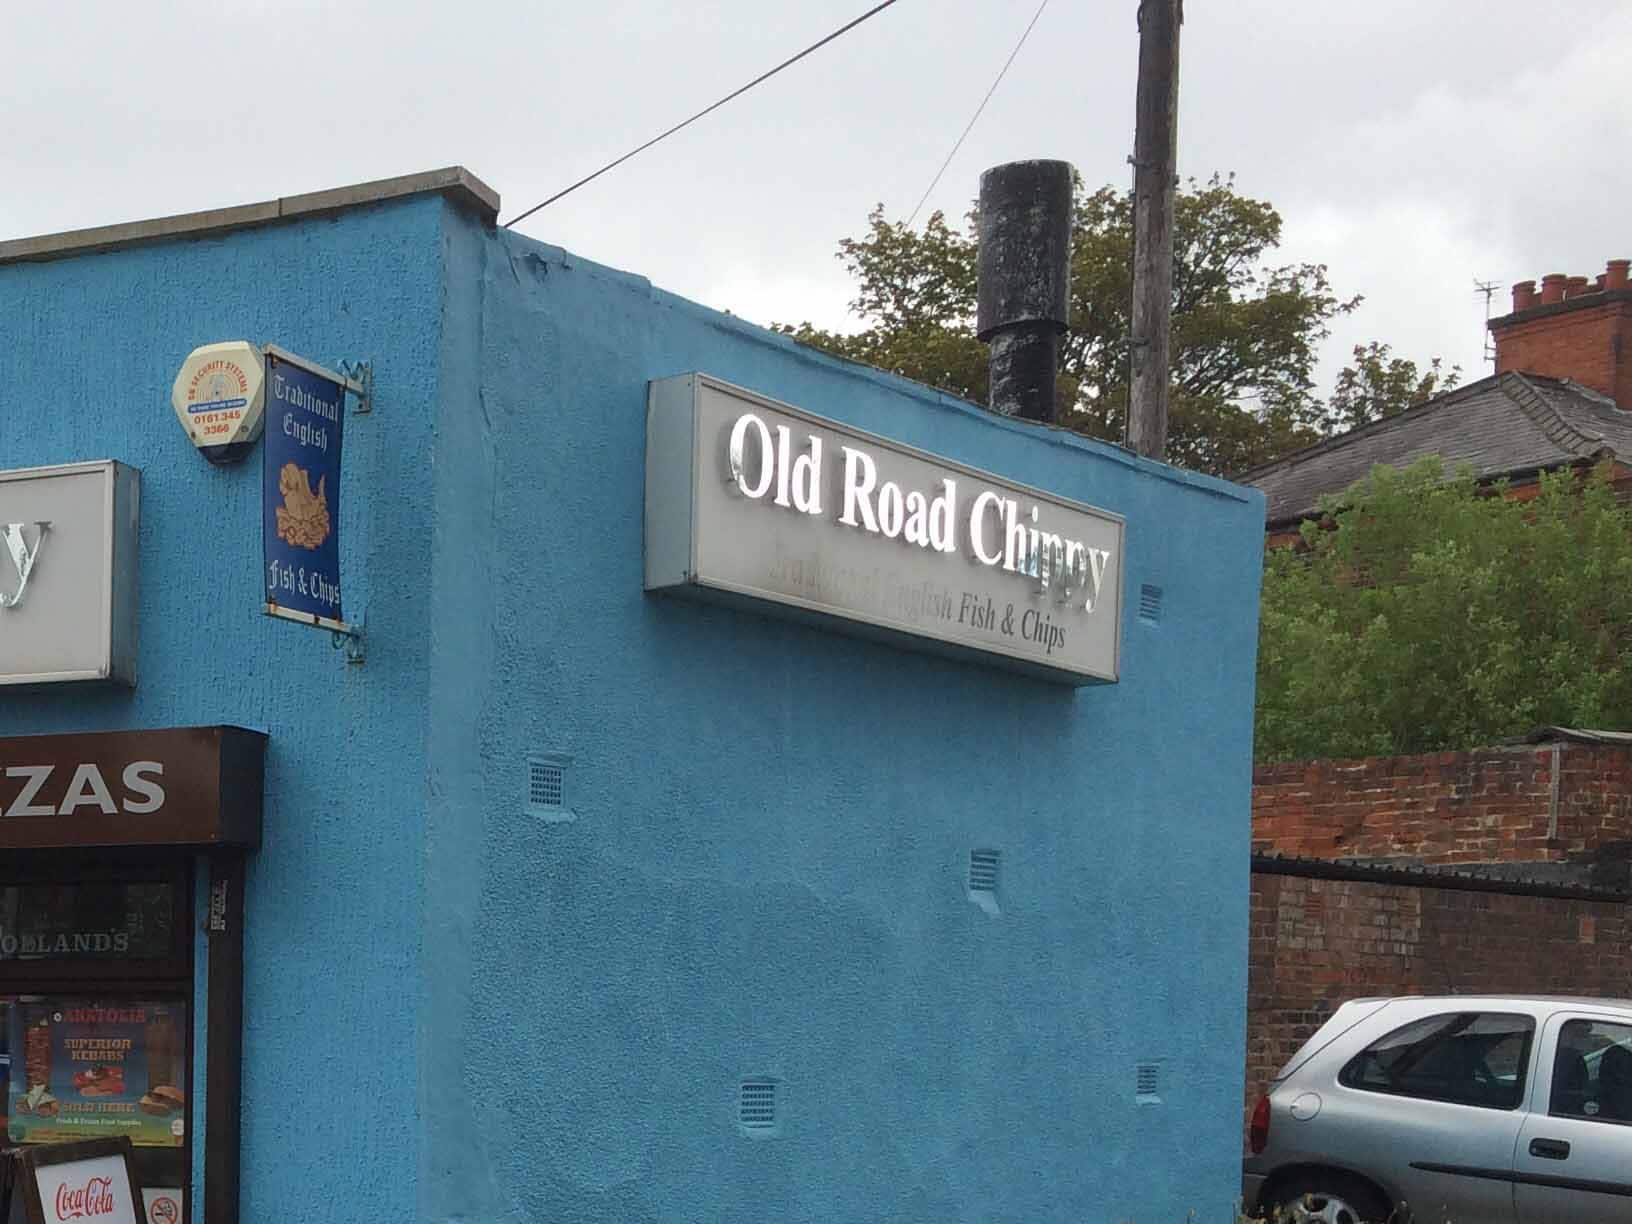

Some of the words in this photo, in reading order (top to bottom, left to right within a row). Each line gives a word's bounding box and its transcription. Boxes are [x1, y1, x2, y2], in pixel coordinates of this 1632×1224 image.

[273, 374, 339, 423] Traditional
[284, 413, 328, 453] English
[729, 413, 823, 515] Old
[839, 446, 956, 553] Road
[969, 491, 1109, 613] Chippy
[269, 560, 295, 595] Fish
[298, 568, 308, 595] &
[310, 572, 340, 607] Chips
[958, 594, 996, 632] Fish
[1001, 605, 1015, 636] &
[1022, 608, 1066, 654] Chips
[64, 1039, 131, 1050] SUPERIOR
[71, 1050, 125, 1061] KEBABS
